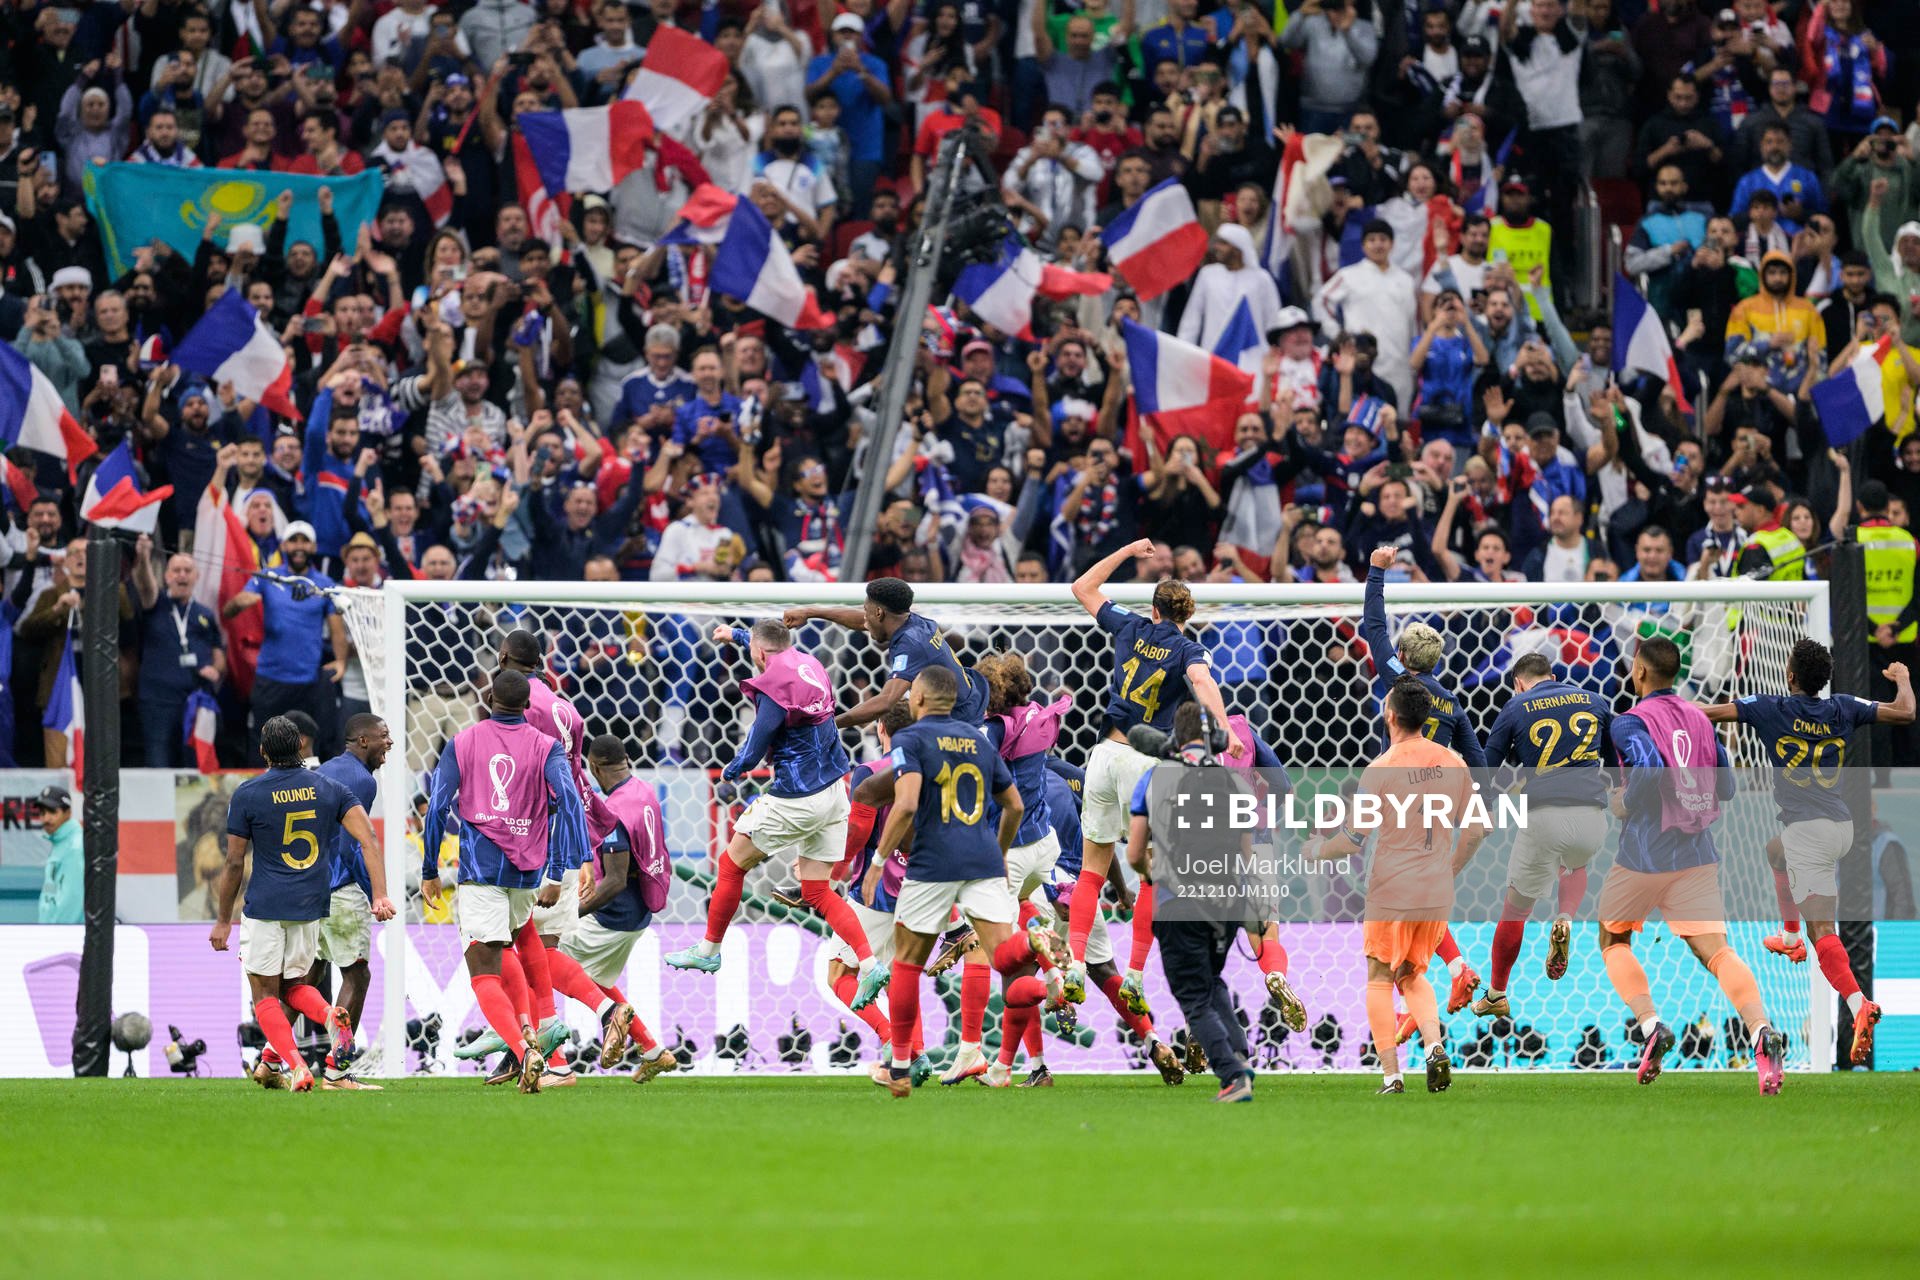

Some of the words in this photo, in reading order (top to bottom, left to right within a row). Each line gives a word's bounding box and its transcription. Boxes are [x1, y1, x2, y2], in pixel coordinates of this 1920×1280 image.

[1121, 656, 1167, 723] 14
[1430, 695, 1454, 716] MANN
[1522, 693, 1592, 713] T.HERNANDEZ
[1793, 718, 1831, 735] COMAN
[937, 737, 978, 754] MBAPPE
[1529, 711, 1599, 776] 22
[1775, 735, 1846, 789] 20
[1067, 778, 1081, 791] NO
[1408, 765, 1443, 785] LLORIS
[272, 787, 317, 804] KOUNDE
[934, 761, 985, 826] 10
[508, 826, 529, 836] 022
[516, 818, 532, 827] CUP
[281, 809, 320, 870] 5
